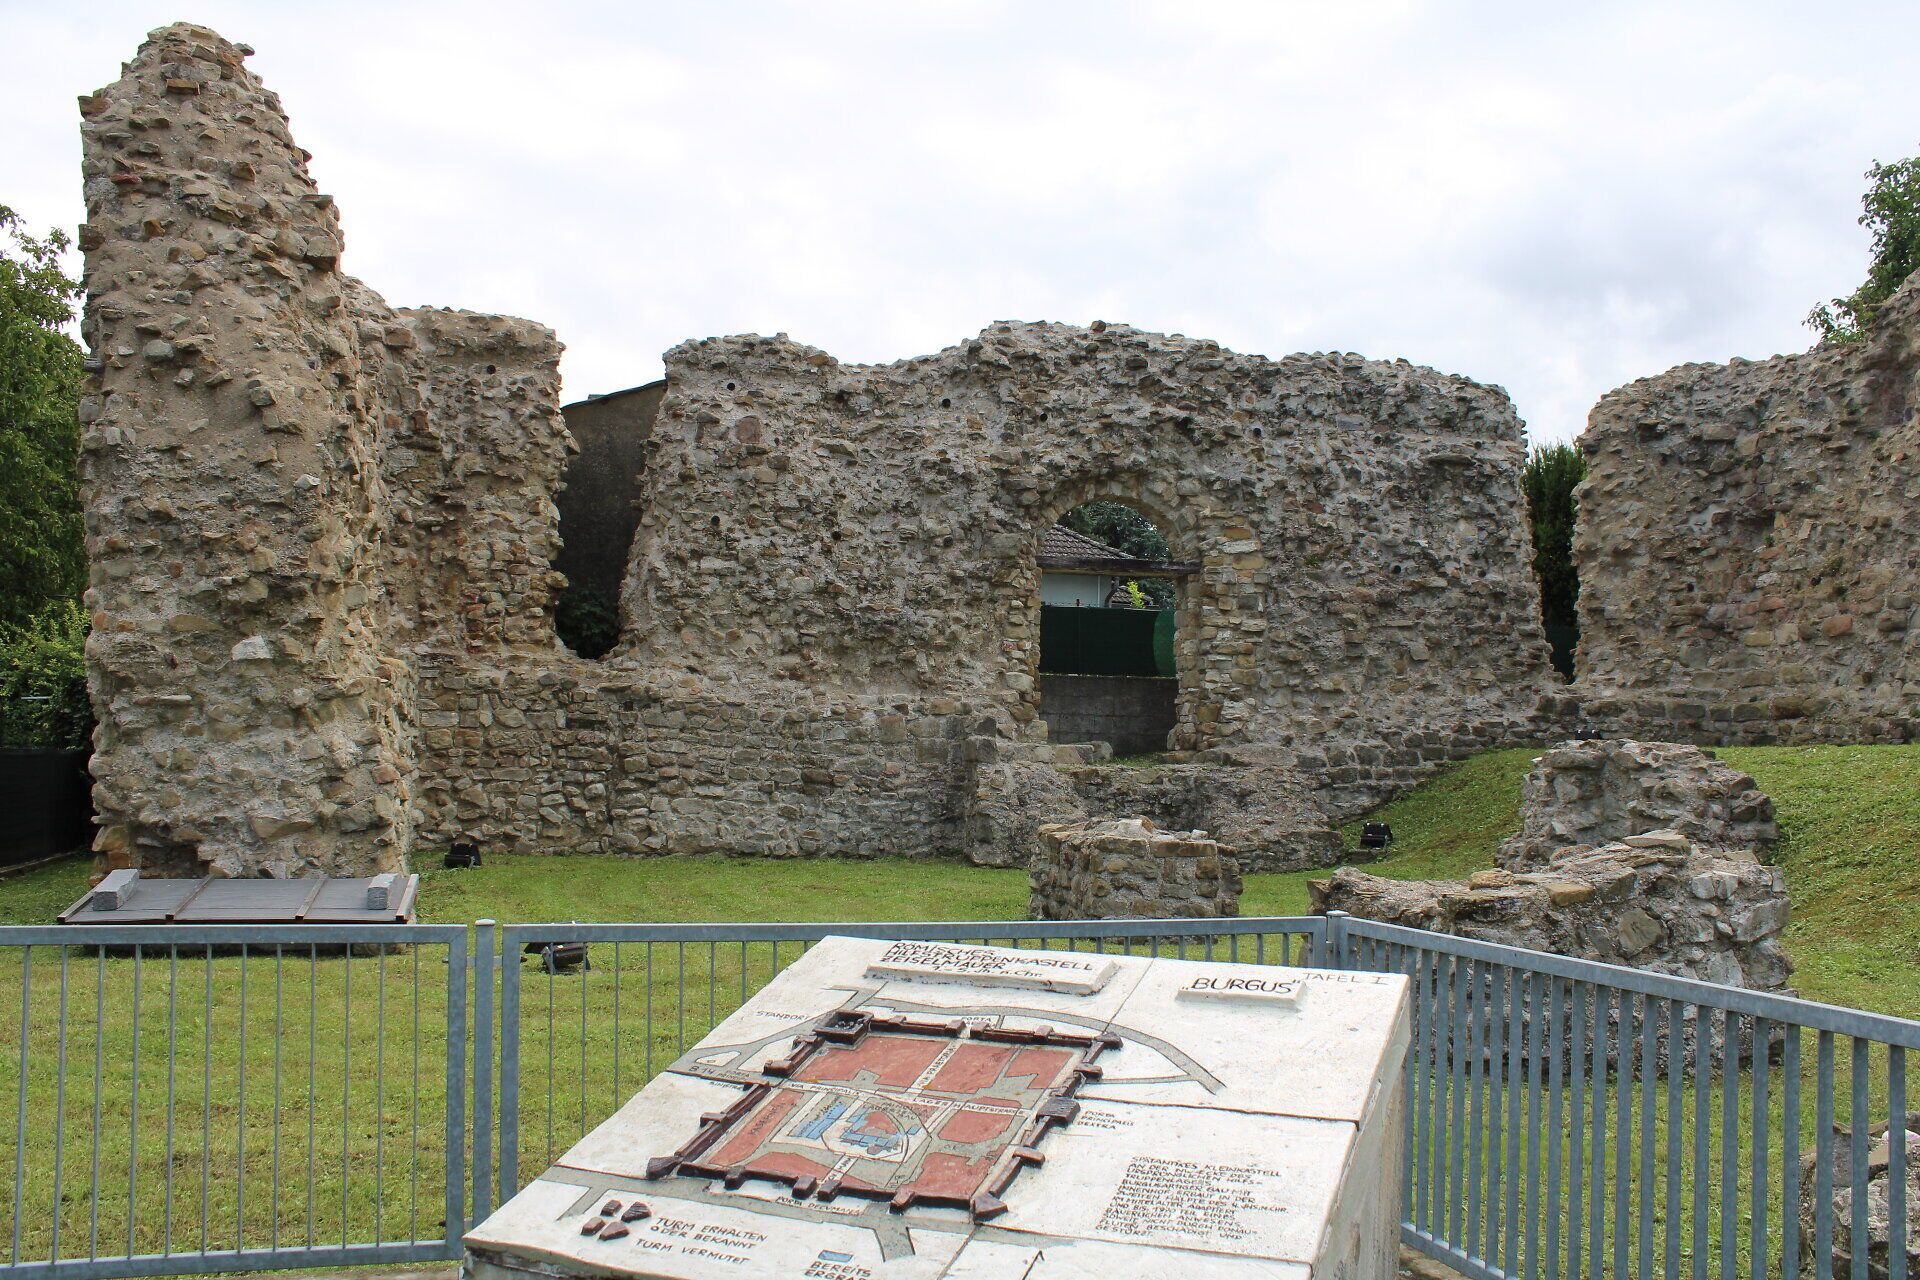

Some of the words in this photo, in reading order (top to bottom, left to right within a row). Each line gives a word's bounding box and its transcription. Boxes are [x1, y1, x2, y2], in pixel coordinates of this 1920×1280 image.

[888, 941, 995, 956] RÖMISCHES
[879, 955, 1007, 970] ZEISELMAUER
[885, 949, 1094, 971] HILFSTRUPPENKASTELL
[1302, 972, 1360, 984] TAFEL
[1204, 1164, 1282, 1177] KLEINKASTELL
[1234, 1196, 1256, 1204] DER
[656, 1217, 696, 1231] TURM
[700, 1224, 769, 1241] ERHALTEN
[635, 1238, 673, 1252] TURM
[650, 1225, 688, 1238] ODER
[693, 1233, 757, 1250] BEKANNT
